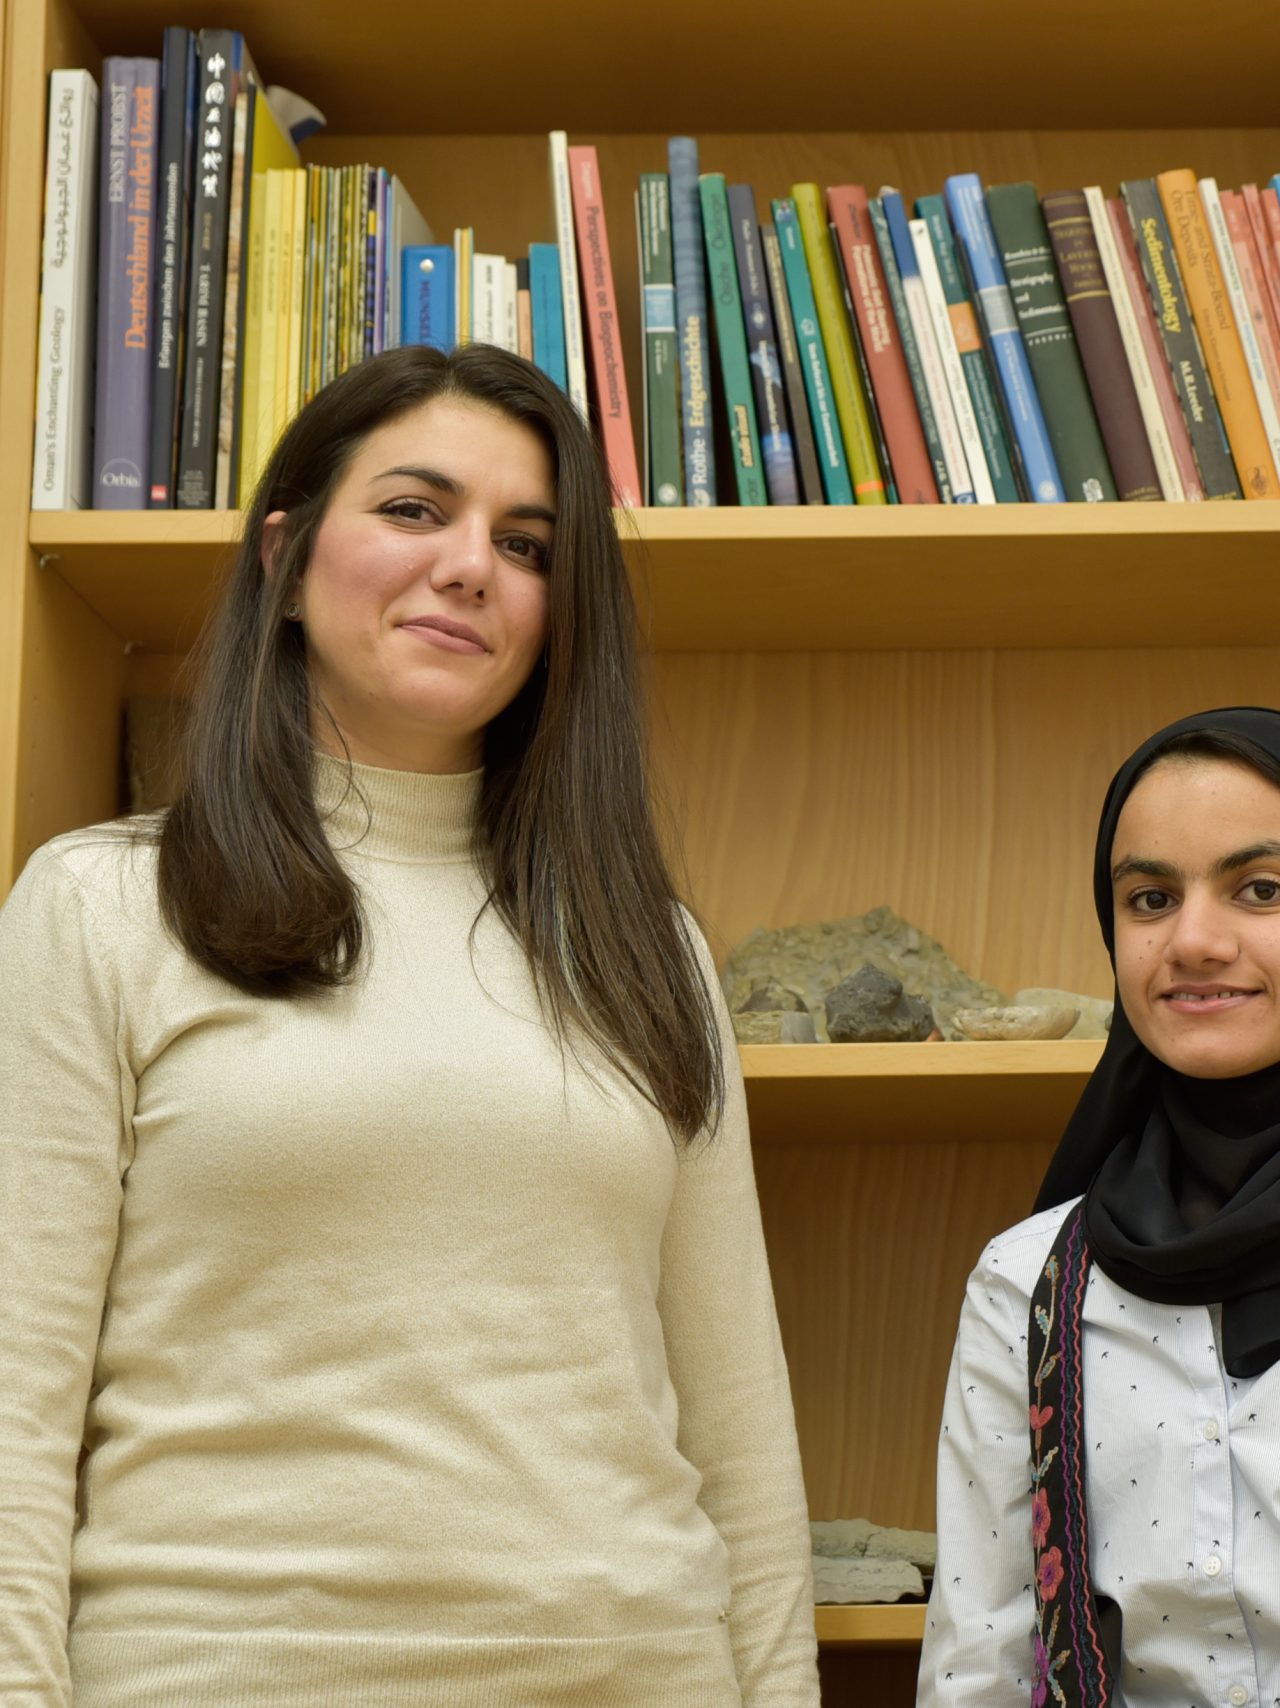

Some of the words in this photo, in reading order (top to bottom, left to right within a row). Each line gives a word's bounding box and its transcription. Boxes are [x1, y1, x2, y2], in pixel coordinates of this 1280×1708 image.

[109, 82, 126, 146] PROBST
[131, 86, 154, 149] Urzeit
[108, 149, 125, 203] ERNST
[130, 148, 152, 186] der
[130, 186, 150, 211] in
[163, 161, 179, 242] Jahrtausenden
[1169, 187, 1185, 213] Ore
[163, 243, 175, 266] den
[582, 204, 608, 288] Perspectives
[1175, 213, 1198, 268] Deposits
[1193, 223, 1210, 249] and
[123, 215, 152, 349] Deutschland
[160, 267, 174, 318] zwischen
[595, 289, 609, 308] on
[1141, 218, 1181, 333] Sedimentology
[1200, 248, 1232, 331] Strata-Bound
[49, 306, 65, 364] Geology
[158, 319, 173, 369] Erlangen
[595, 309, 625, 419] Biogeochemistry
[684, 315, 705, 427] Erdgeschichte
[44, 365, 62, 440] Enchanting
[42, 441, 56, 491] Oman's
[102, 472, 139, 487] Orbis
[690, 437, 706, 484] Rothe
